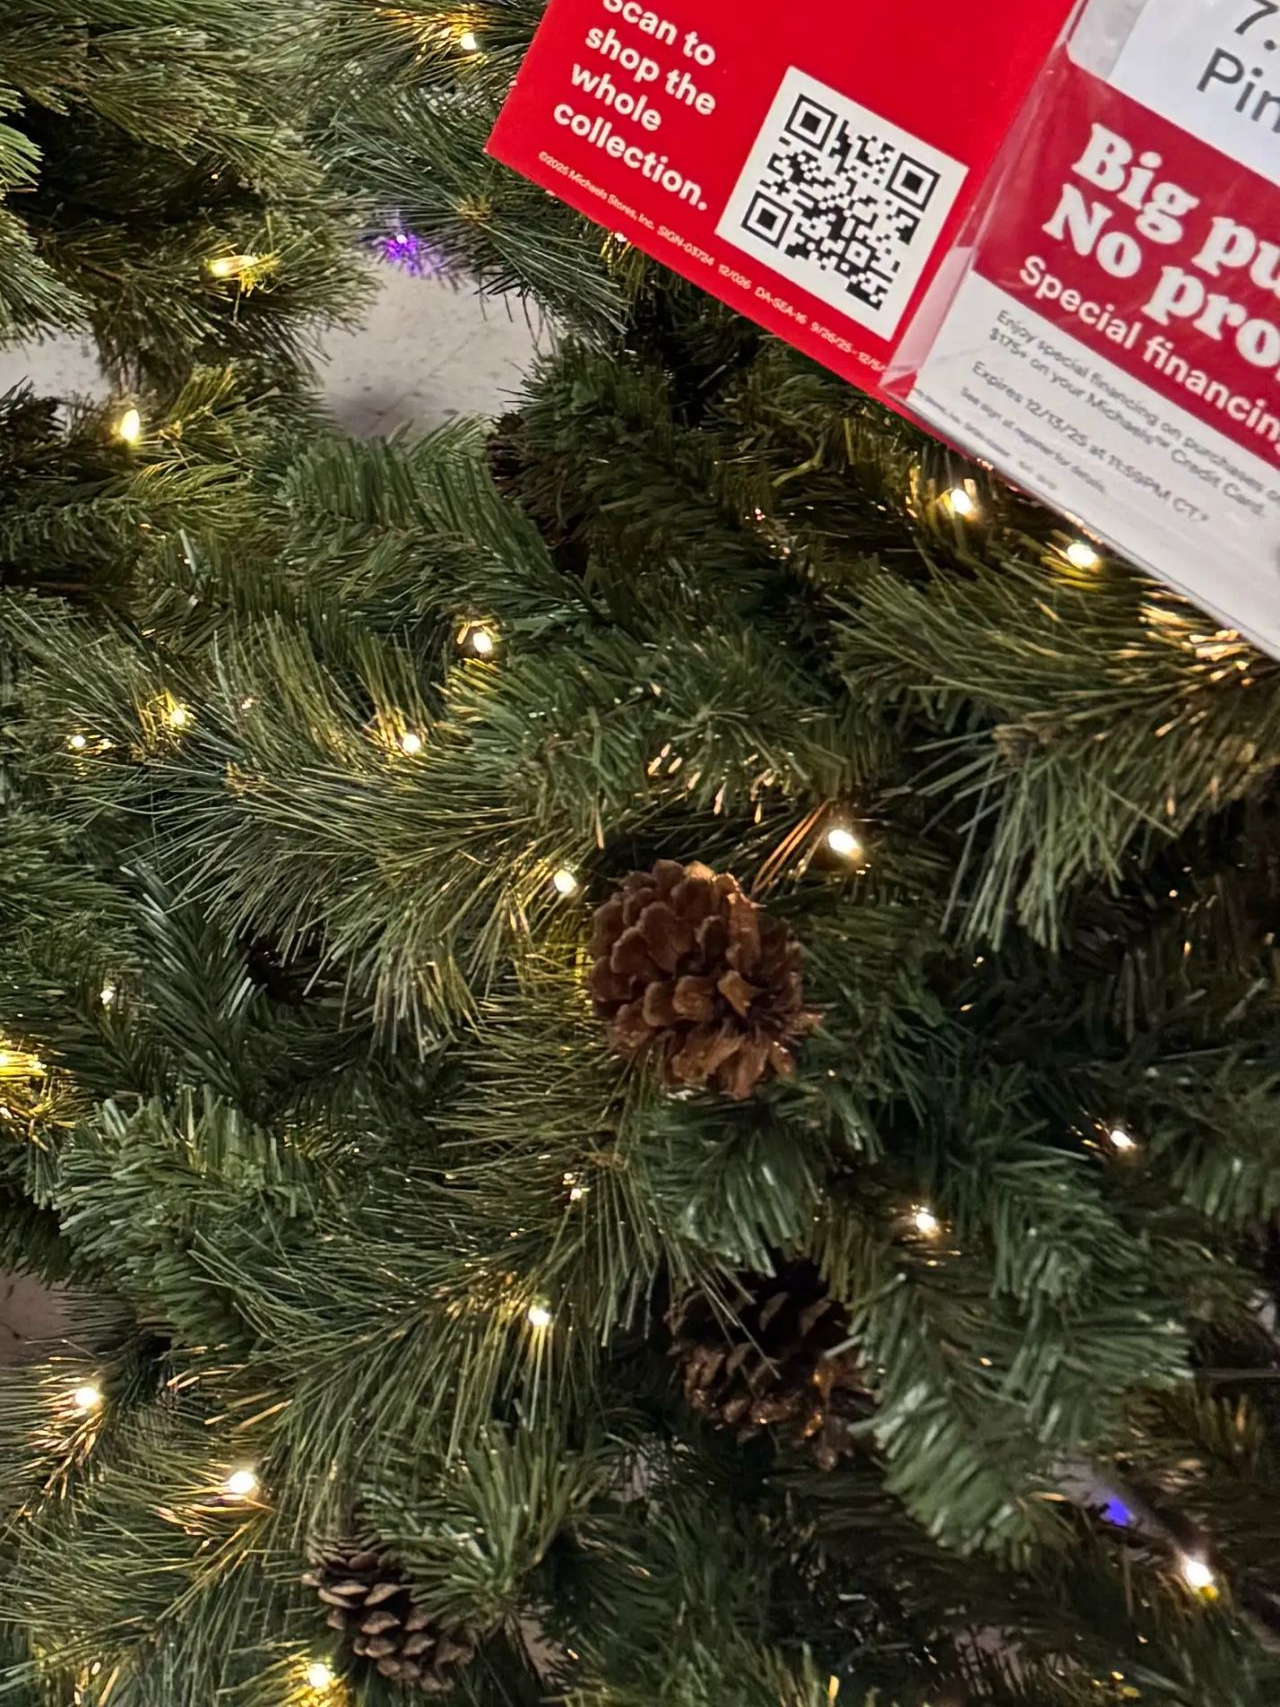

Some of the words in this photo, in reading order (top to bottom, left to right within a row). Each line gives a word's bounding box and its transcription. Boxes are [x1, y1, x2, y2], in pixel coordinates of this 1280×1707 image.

[584, 27, 660, 83] shop
[664, 68, 716, 115] the
[682, 30, 716, 66] to
[570, 62, 662, 132] whole
[552, 103, 707, 211] collection.
[1072, 123, 1200, 245] Big
[1043, 183, 1140, 279] No
[1018, 254, 1143, 349] Special
